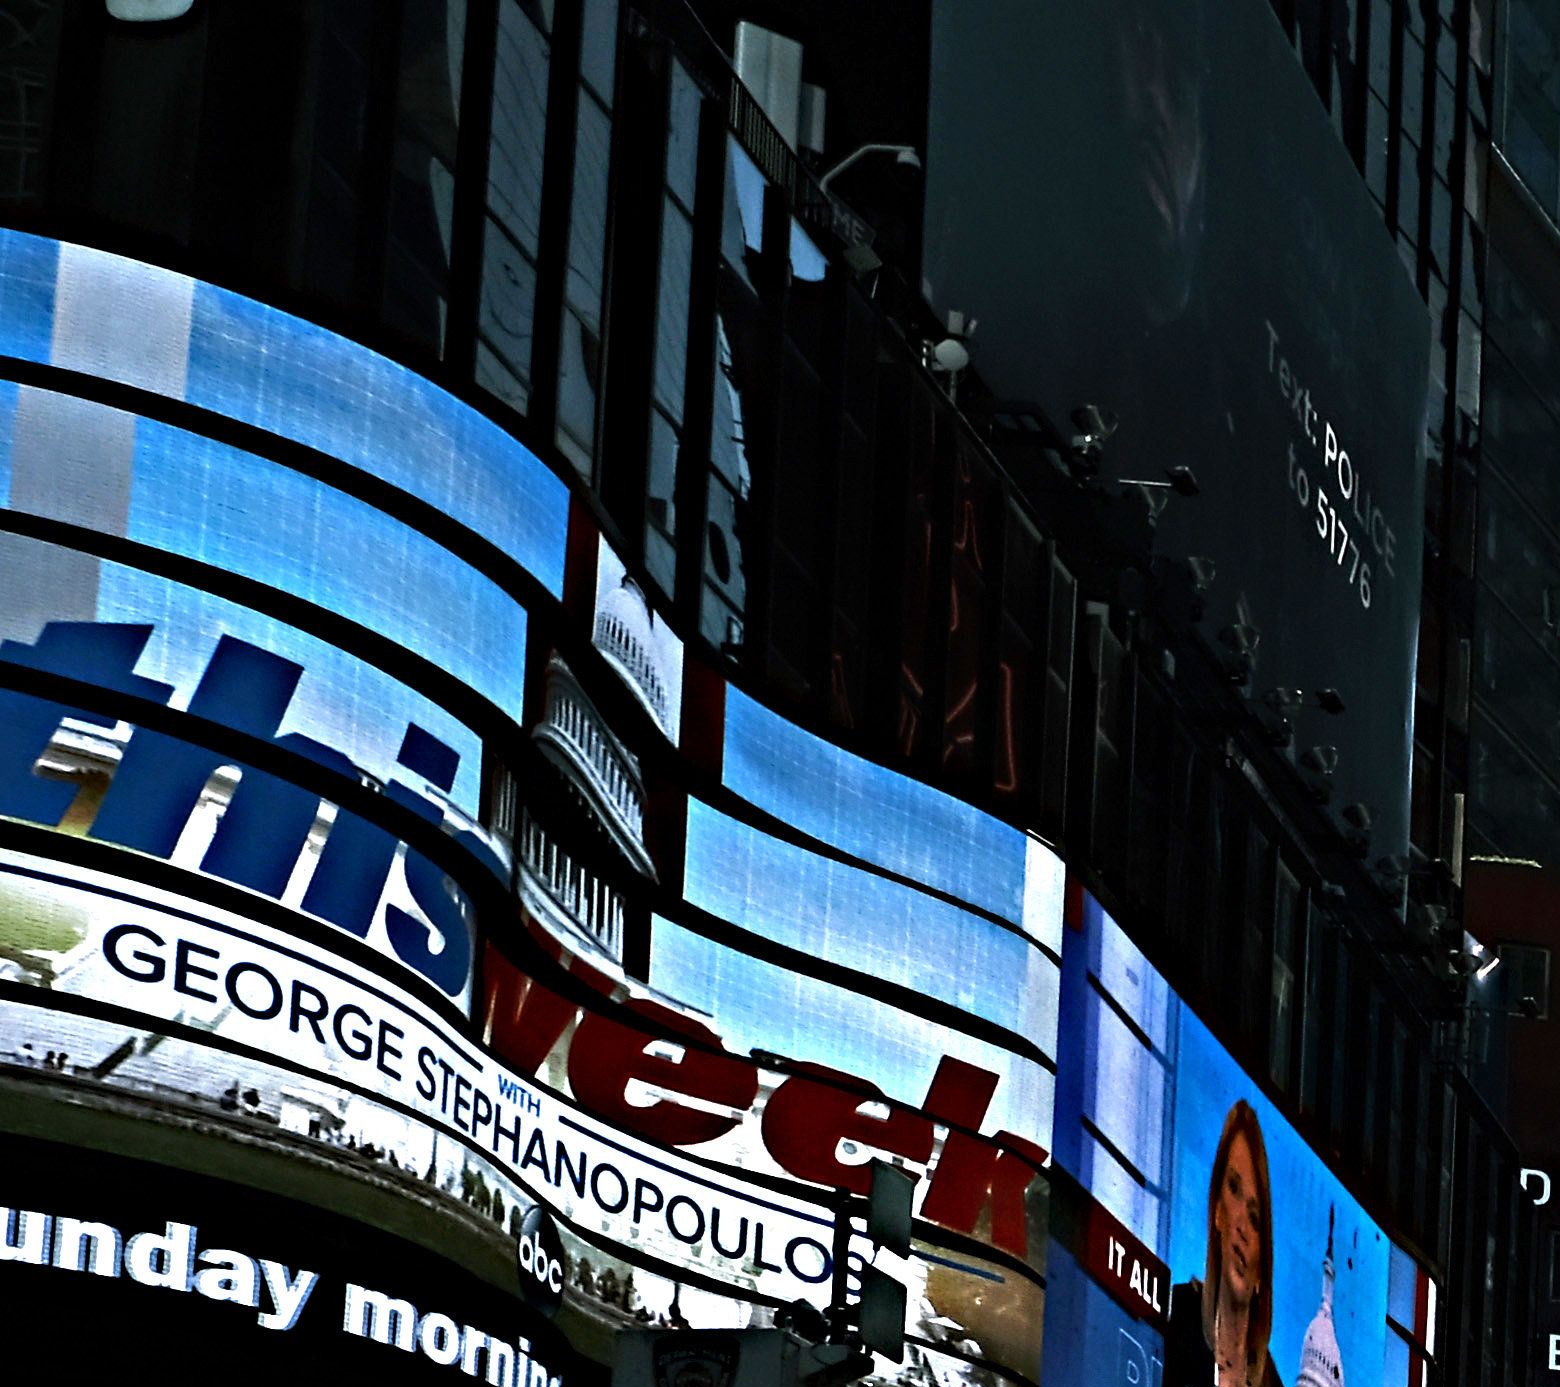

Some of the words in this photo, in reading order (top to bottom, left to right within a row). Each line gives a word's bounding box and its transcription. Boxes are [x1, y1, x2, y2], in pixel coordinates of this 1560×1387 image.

[1264, 317, 1319, 448] Text:
[1323, 420, 1396, 579] POLICE
[1287, 441, 1309, 508] to
[1315, 486, 1372, 610] 51776
[102, 923, 404, 1084] GEORGE
[497, 1072, 543, 1118] WITH
[518, 1229, 564, 1295] abc
[1107, 1235, 1125, 1280] IT
[1129, 1258, 1162, 1314] ALL
